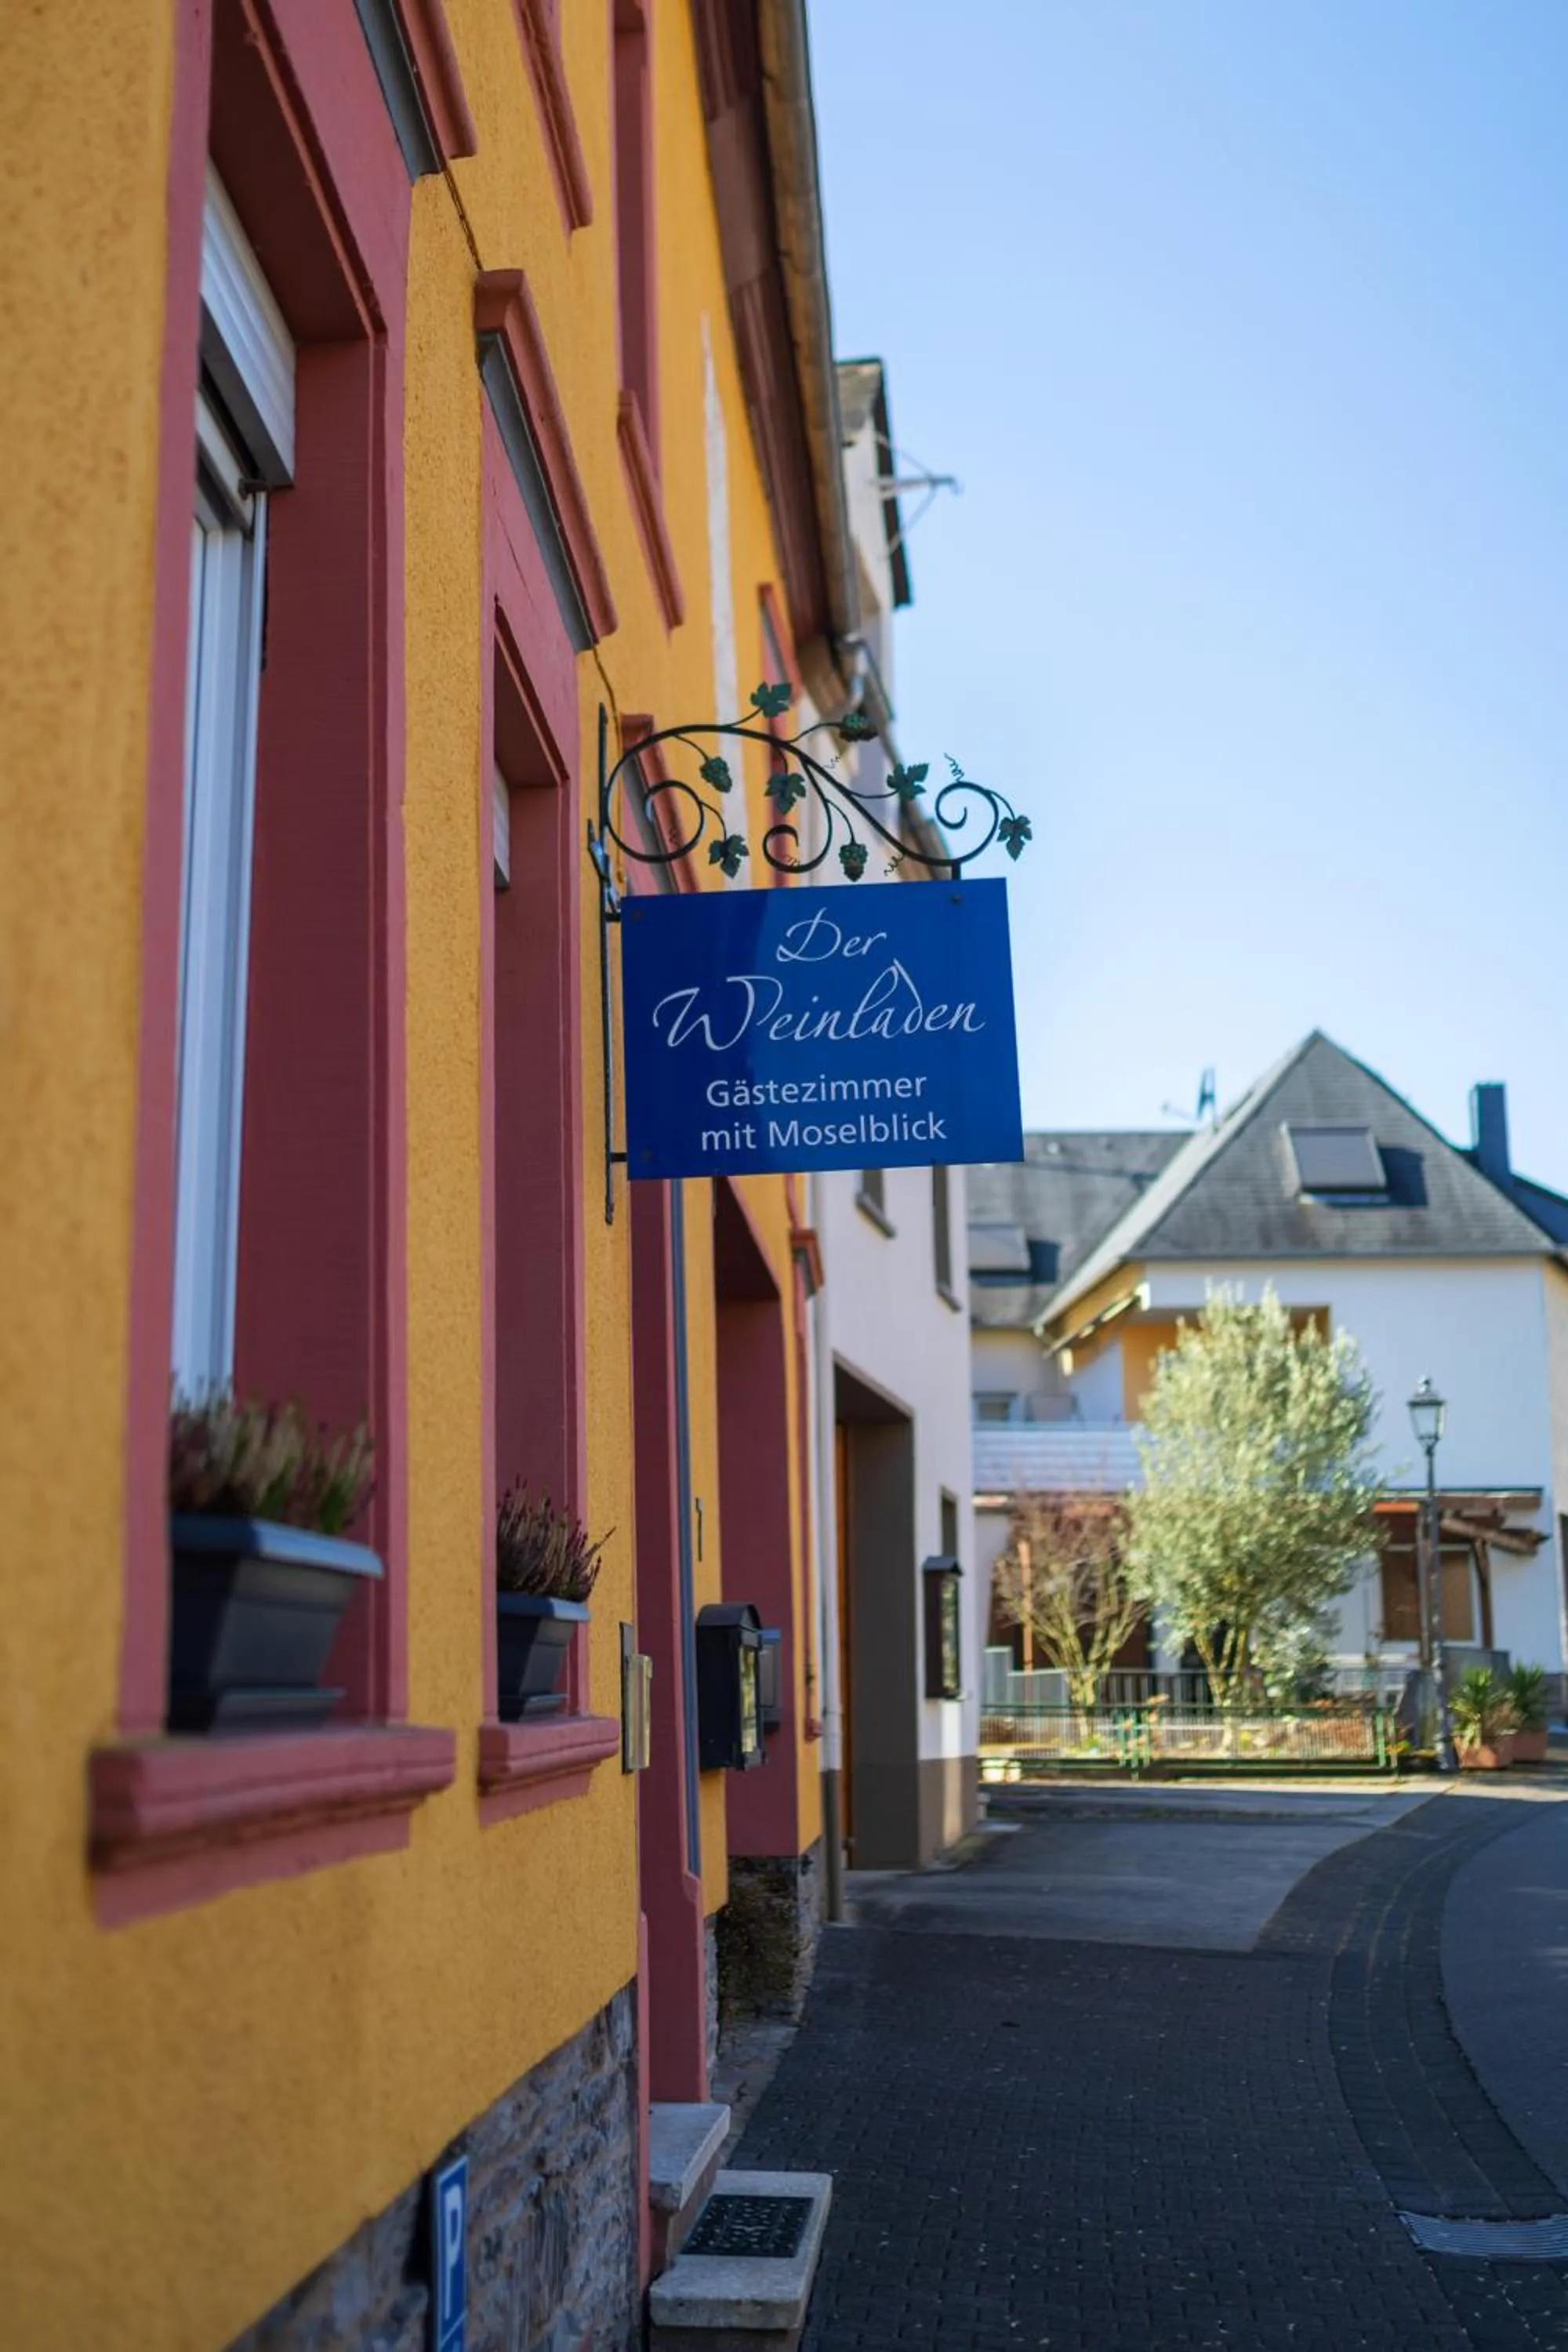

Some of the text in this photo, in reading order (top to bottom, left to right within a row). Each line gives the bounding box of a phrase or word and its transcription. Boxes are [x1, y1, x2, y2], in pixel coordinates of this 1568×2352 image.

[775, 907, 887, 963] Der
[652, 958, 985, 1051] Weinladen
[706, 1074, 927, 1107] Gästezimmer
[702, 1112, 947, 1151] mit Moselblick
[445, 2183, 463, 2321] P
